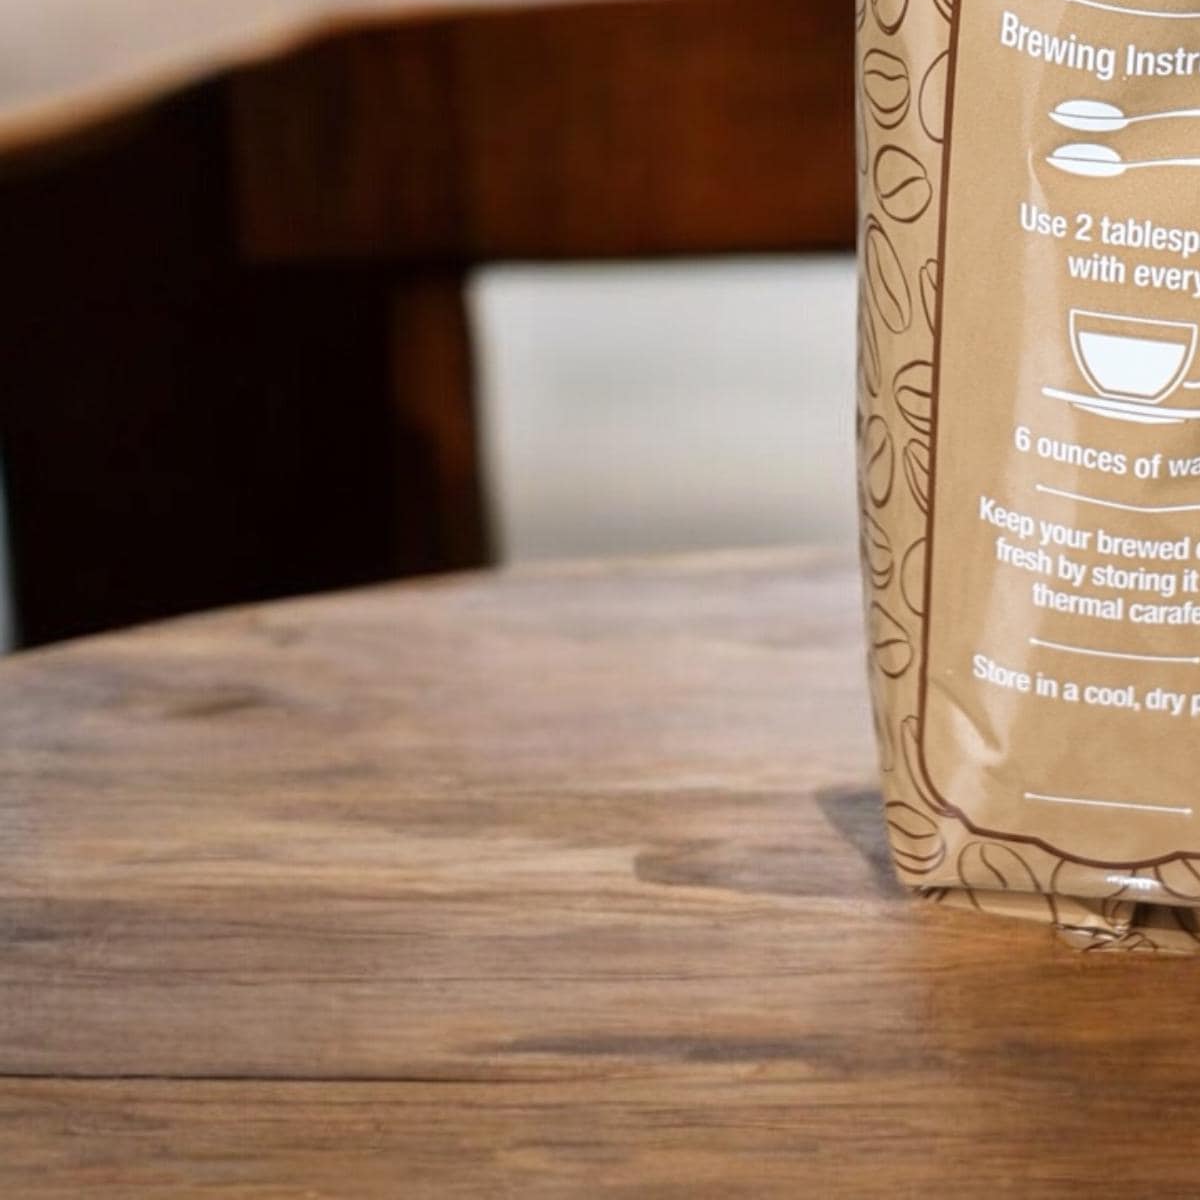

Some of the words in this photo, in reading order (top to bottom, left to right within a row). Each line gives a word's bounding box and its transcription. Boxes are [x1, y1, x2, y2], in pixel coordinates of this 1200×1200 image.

[1001, 11, 1115, 80] Brewing
[1020, 202, 1067, 238] Use
[1075, 213, 1093, 241] 2
[1068, 253, 1125, 283] with
[1014, 426, 1031, 451] 6
[1037, 435, 1127, 476] ounces
[1134, 454, 1161, 479] of
[979, 496, 1034, 538] Keep
[1039, 518, 1091, 549] your
[1097, 530, 1190, 560] brewed
[995, 537, 1051, 575] fresh
[1058, 554, 1086, 586] by
[1092, 563, 1176, 598] storing
[1182, 569, 1198, 592] it
[1032, 582, 1123, 620] thermal
[972, 654, 1030, 693] Store
[1036, 672, 1058, 698] in
[1063, 681, 1079, 701] a
[1084, 684, 1141, 711] cool,
[1145, 687, 1185, 716] dry
